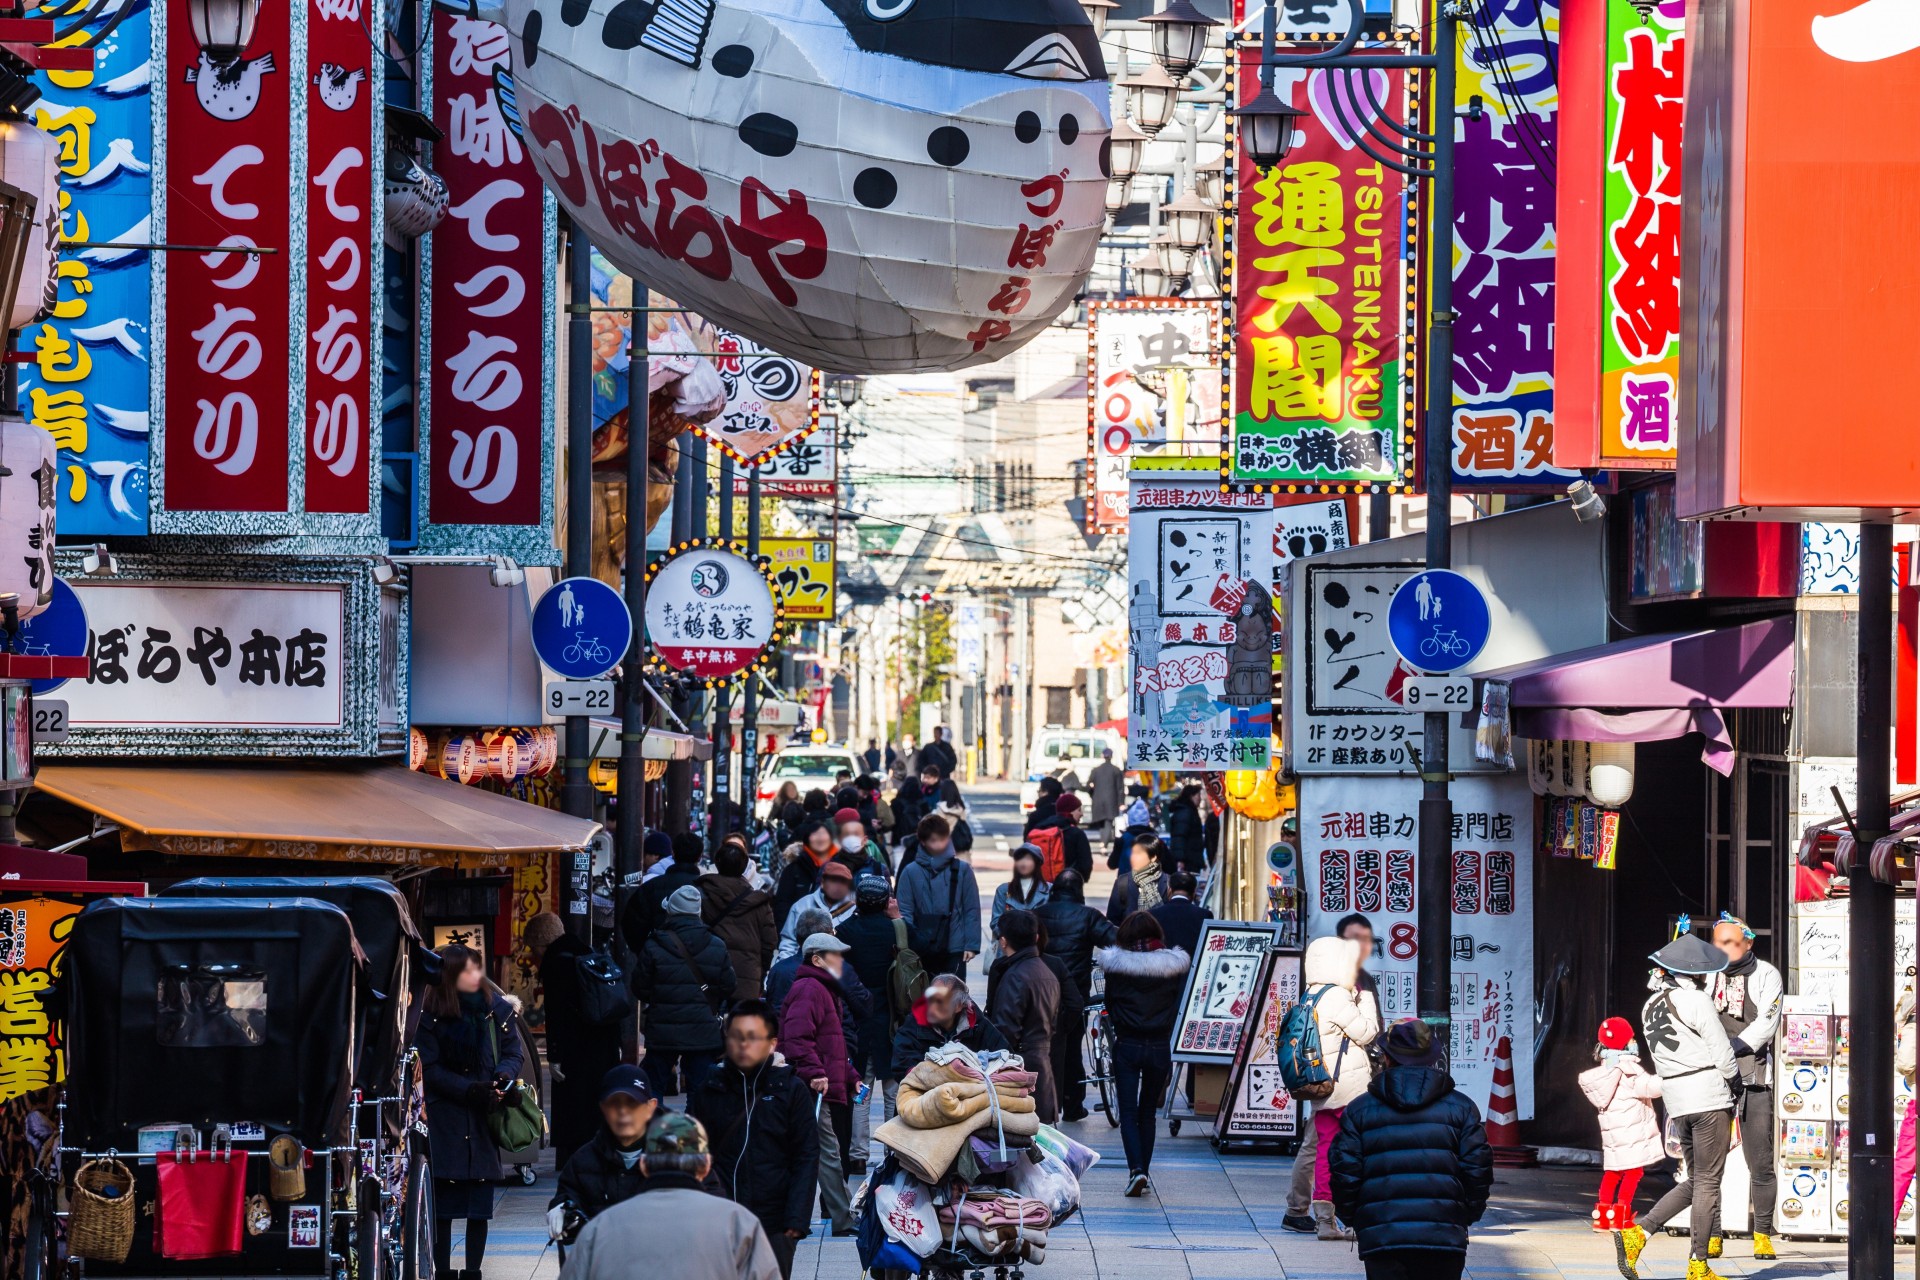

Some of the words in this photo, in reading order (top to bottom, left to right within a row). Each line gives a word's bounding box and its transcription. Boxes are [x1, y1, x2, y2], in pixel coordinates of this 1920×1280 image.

[529, 104, 828, 307] づぼらや
[967, 168, 1070, 353] づぼらや
[1251, 161, 1346, 420] 通天閣
[1352, 161, 1383, 418] TSUTENKAKU
[1625, 381, 1679, 444] 酒
[1239, 435, 1292, 450] 日本一の
[1239, 452, 1292, 469] 串かつ
[1293, 429, 1383, 473] 横綱
[683, 612, 756, 640] 鶴亀家
[86, 623, 328, 688] ぼらや本店
[681, 649, 737, 664] 年中無休
[1136, 652, 1230, 695] 大阪名物
[1135, 742, 1266, 763] 宴会予約受付中
[1320, 811, 1513, 841] 元祖串カ専門店
[1323, 851, 1347, 911] 大阪名物
[1355, 851, 1380, 911] 串カツ
[1388, 851, 1413, 912] どて焼き
[1454, 852, 1478, 912] たこ焼き
[1487, 852, 1513, 914] 味自慢
[16, 910, 26, 965] 日本一の串かつ
[1387, 974, 1396, 1011] いわし
[1403, 975, 1413, 1011] ホタテ
[1466, 982, 1476, 1006] たこ
[1464, 1022, 1474, 1058] キムチ
